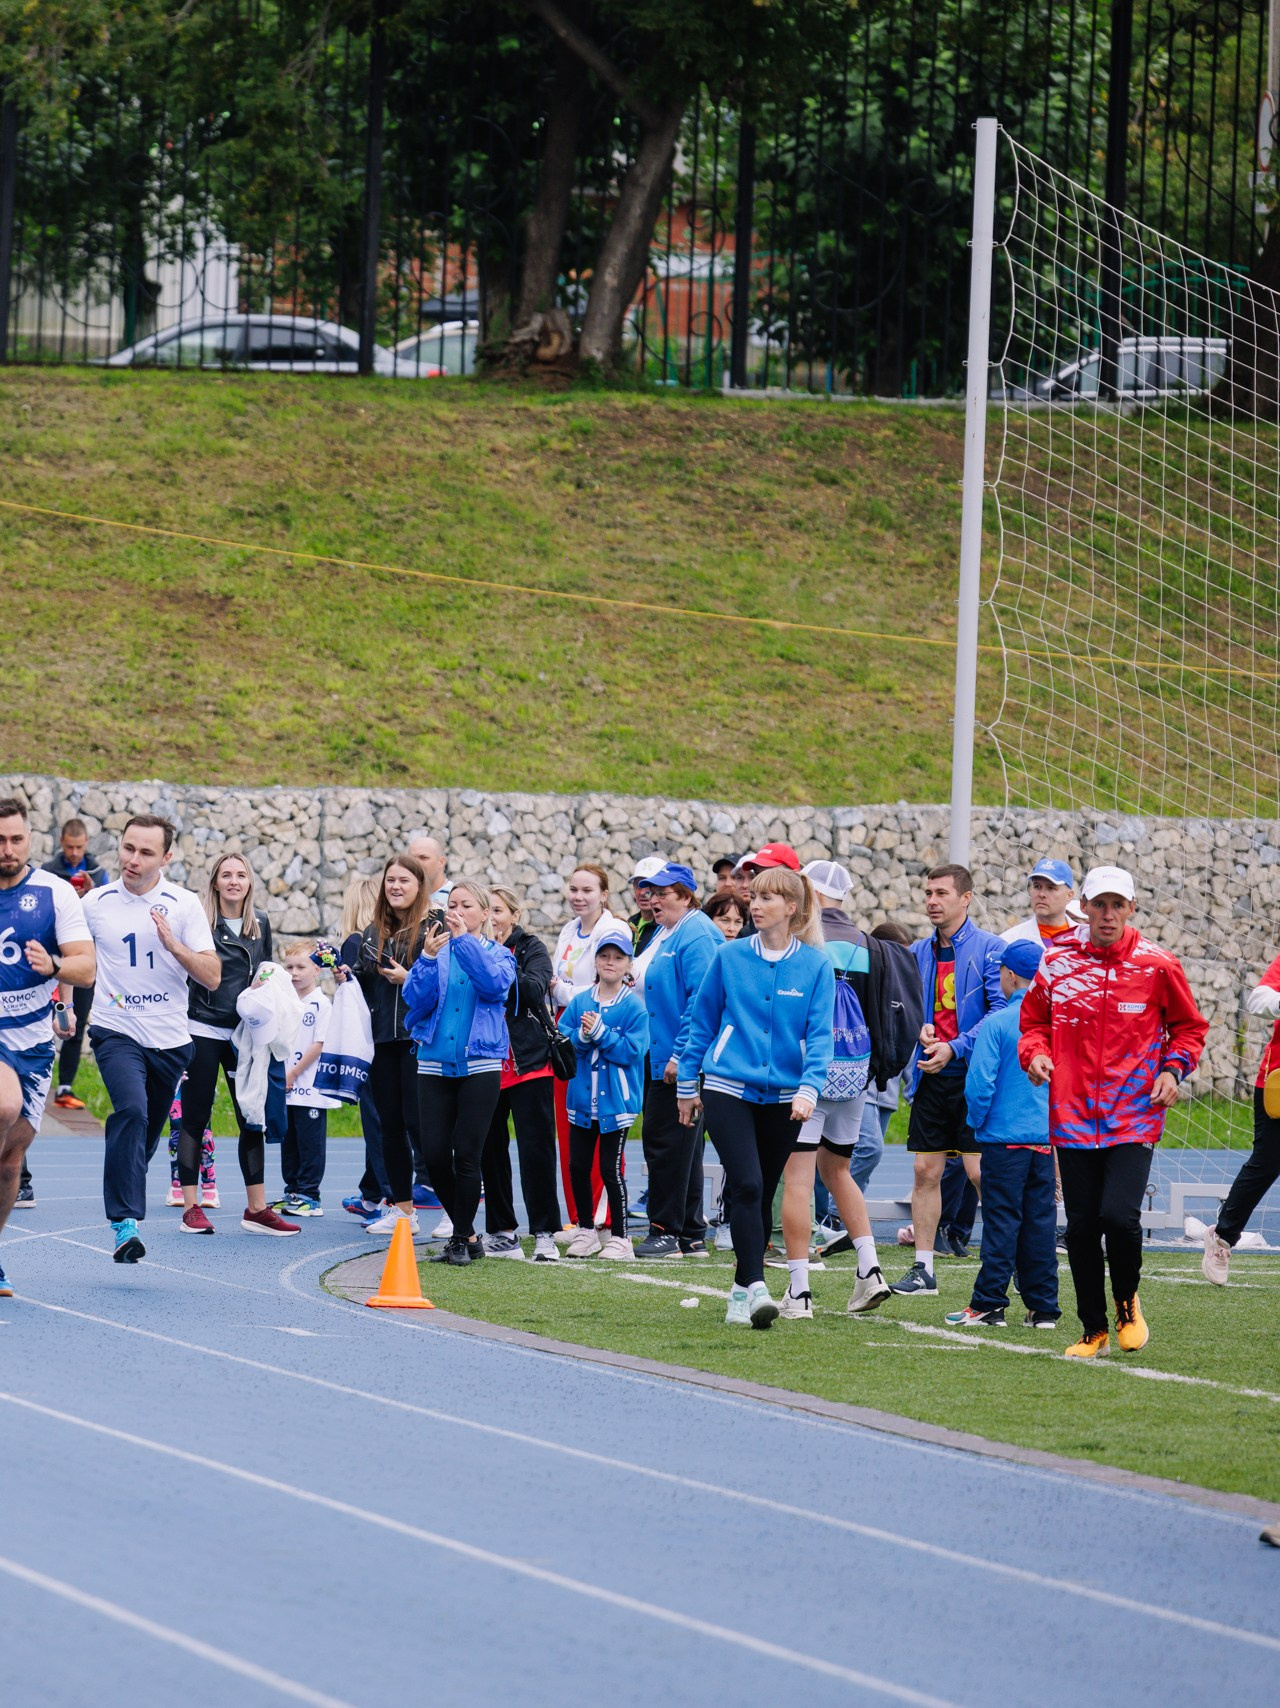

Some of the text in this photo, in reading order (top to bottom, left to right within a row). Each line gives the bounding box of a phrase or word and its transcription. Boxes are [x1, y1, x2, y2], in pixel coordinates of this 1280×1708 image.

[122, 933, 137, 967] 1
[2, 990, 36, 1004] КОМОС
[125, 993, 169, 1004] КОМОС
